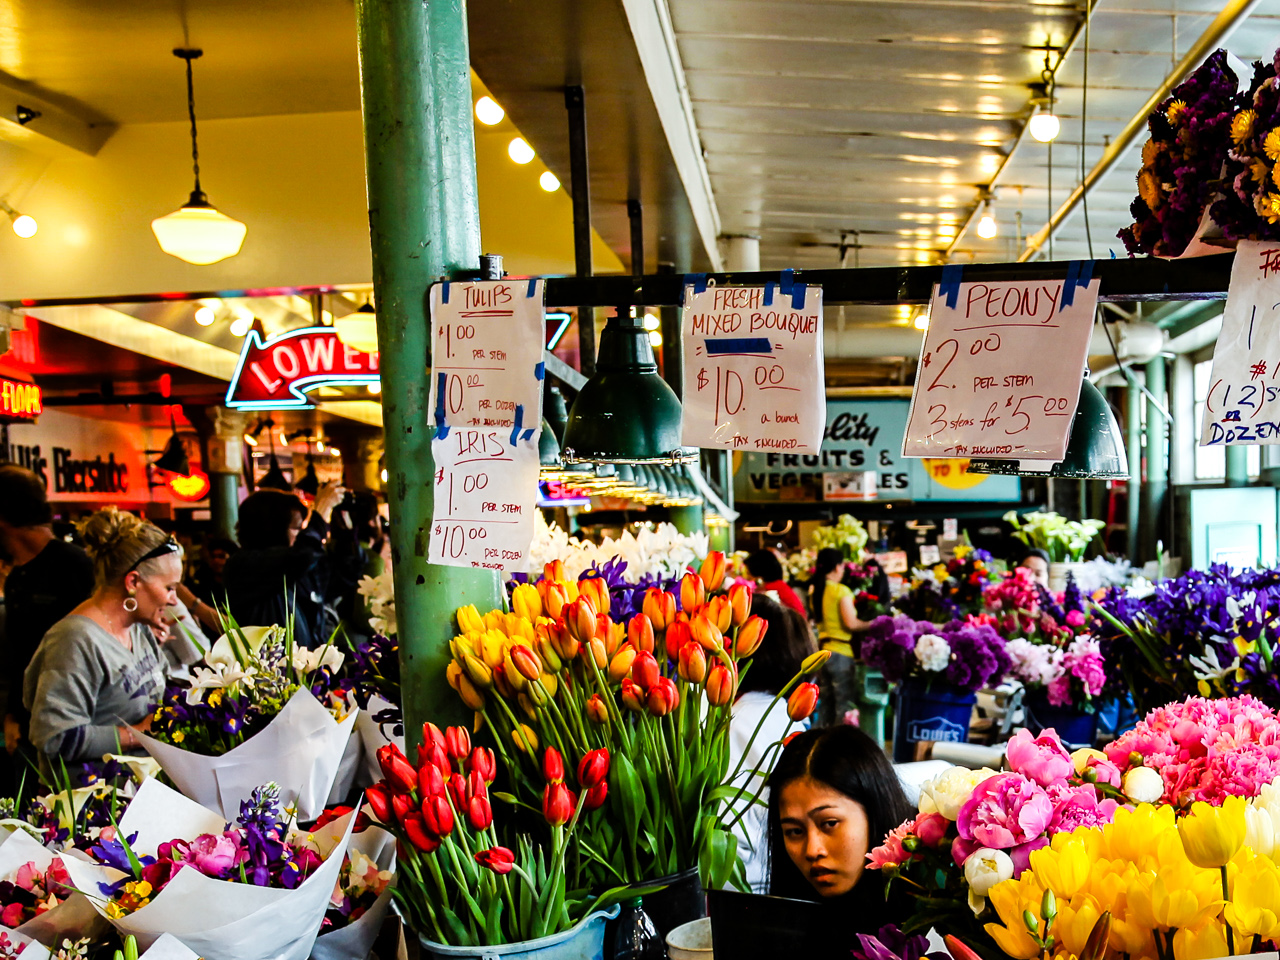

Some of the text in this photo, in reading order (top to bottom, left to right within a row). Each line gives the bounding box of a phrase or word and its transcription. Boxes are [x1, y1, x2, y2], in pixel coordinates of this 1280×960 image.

[463, 285, 512, 309] TULIPS
[713, 288, 761, 311] FRESH
[965, 284, 1061, 323] PEONY
[691, 311, 818, 340] MIXED BOUQUET
[472, 349, 507, 361] PER STEM
[973, 375, 1034, 393] PER STEM
[478, 399, 492, 412] PER
[761, 411, 800, 425] a bunch
[924, 403, 947, 439] 3
[950, 413, 974, 430] stems
[980, 402, 1001, 431] for
[455, 431, 505, 457] IRIS
[767, 449, 894, 467] FRUITS &
[481, 501, 522, 515] PER STEM
[484, 548, 499, 560] PER
